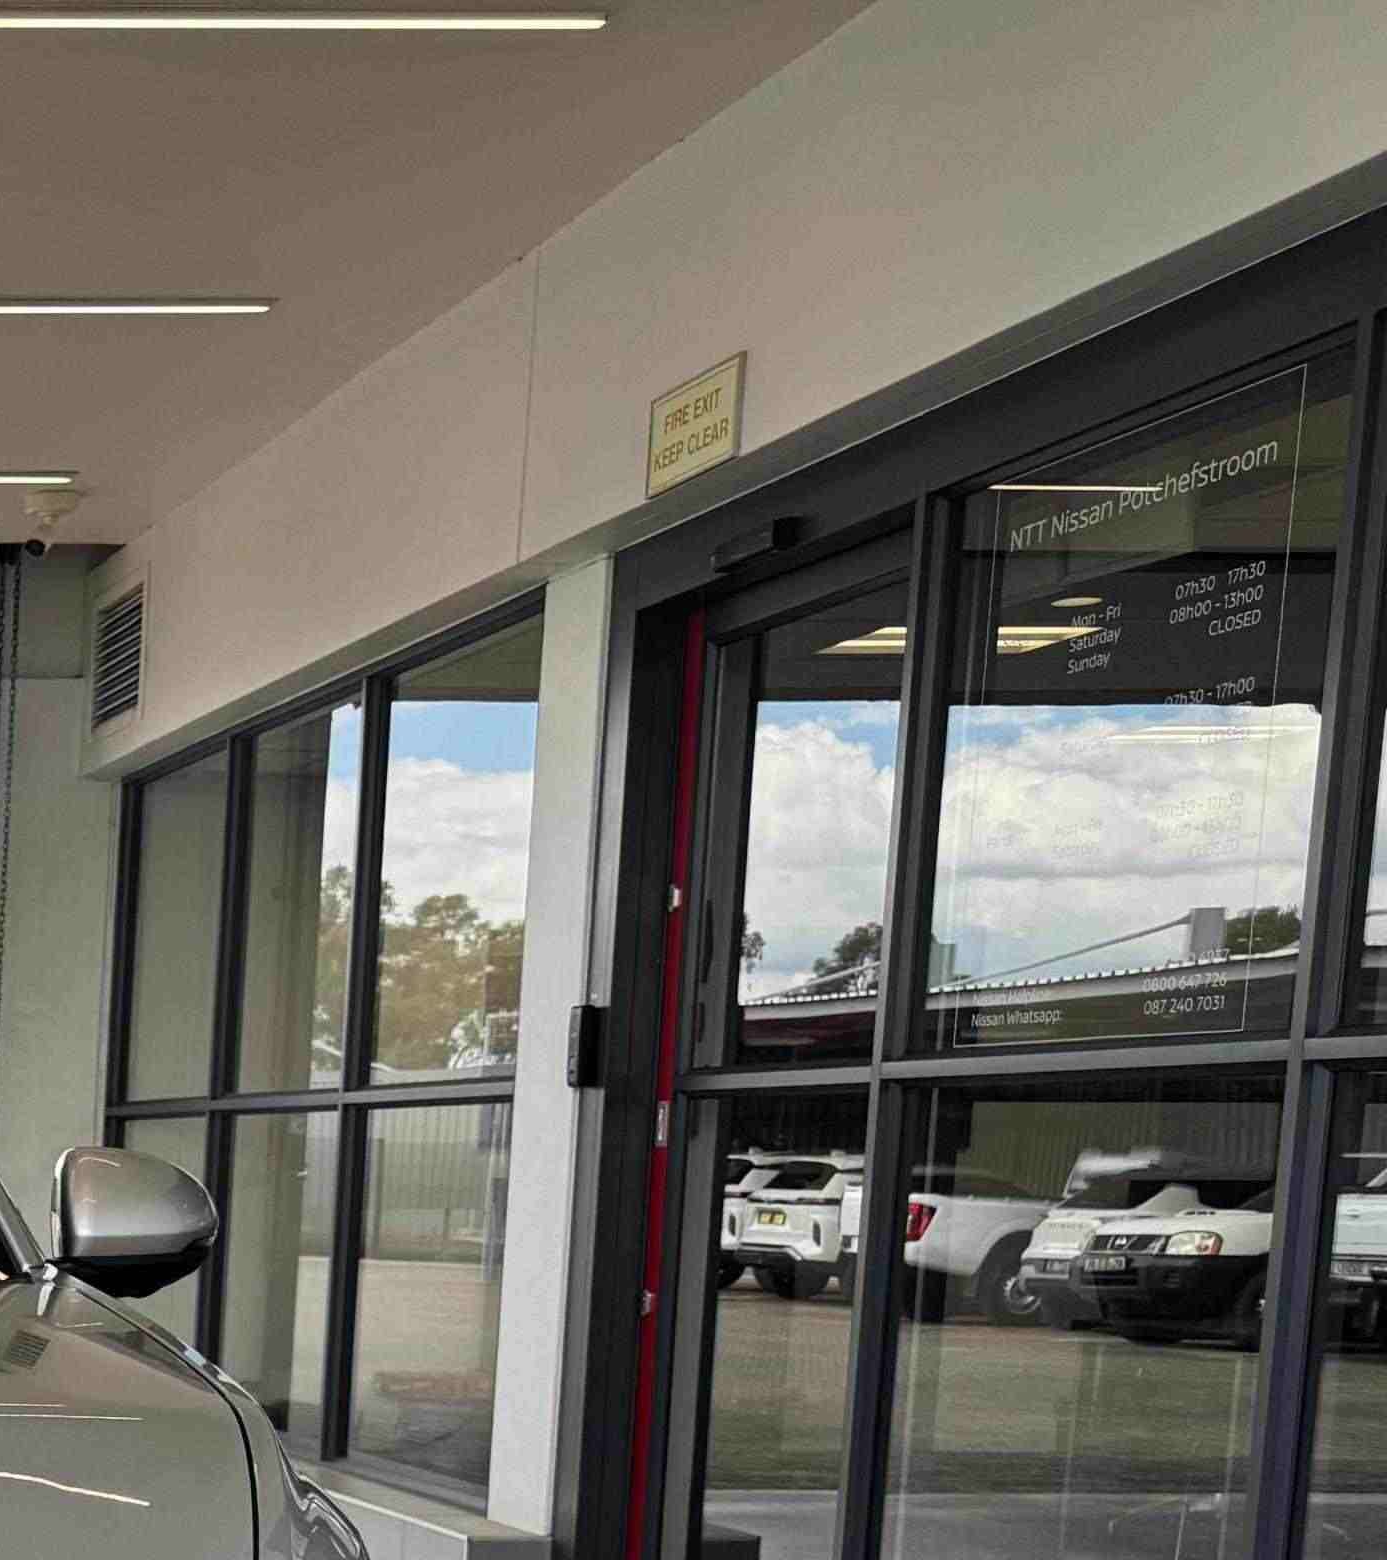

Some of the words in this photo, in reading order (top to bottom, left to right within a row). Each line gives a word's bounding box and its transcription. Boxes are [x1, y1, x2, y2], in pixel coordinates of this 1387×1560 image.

[663, 403, 691, 435] FIRE
[693, 387, 723, 419] EXIT
[653, 441, 684, 473] KEEP
[687, 416, 729, 455] CLEAR
[1010, 519, 1048, 552] NTT
[1050, 500, 1113, 539] Nissan
[1118, 440, 1278, 515] Potchefstroom
[1174, 575, 1216, 601] 07h30
[1227, 560, 1266, 585] 17h30
[1071, 613, 1096, 627] Mon
[1106, 603, 1123, 622] Fri
[1169, 599, 1212, 625] 08h00
[1224, 585, 1264, 609] 13h00
[1208, 609, 1261, 636] CLOSED
[1068, 626, 1122, 653] Saturday
[1066, 652, 1111, 675] Sunday
[1216, 676, 1256, 698] 17h00
[971, 1013, 1005, 1027] Nissan
[1143, 1000, 1165, 1016] 087
[1168, 998, 1194, 1013] 240
